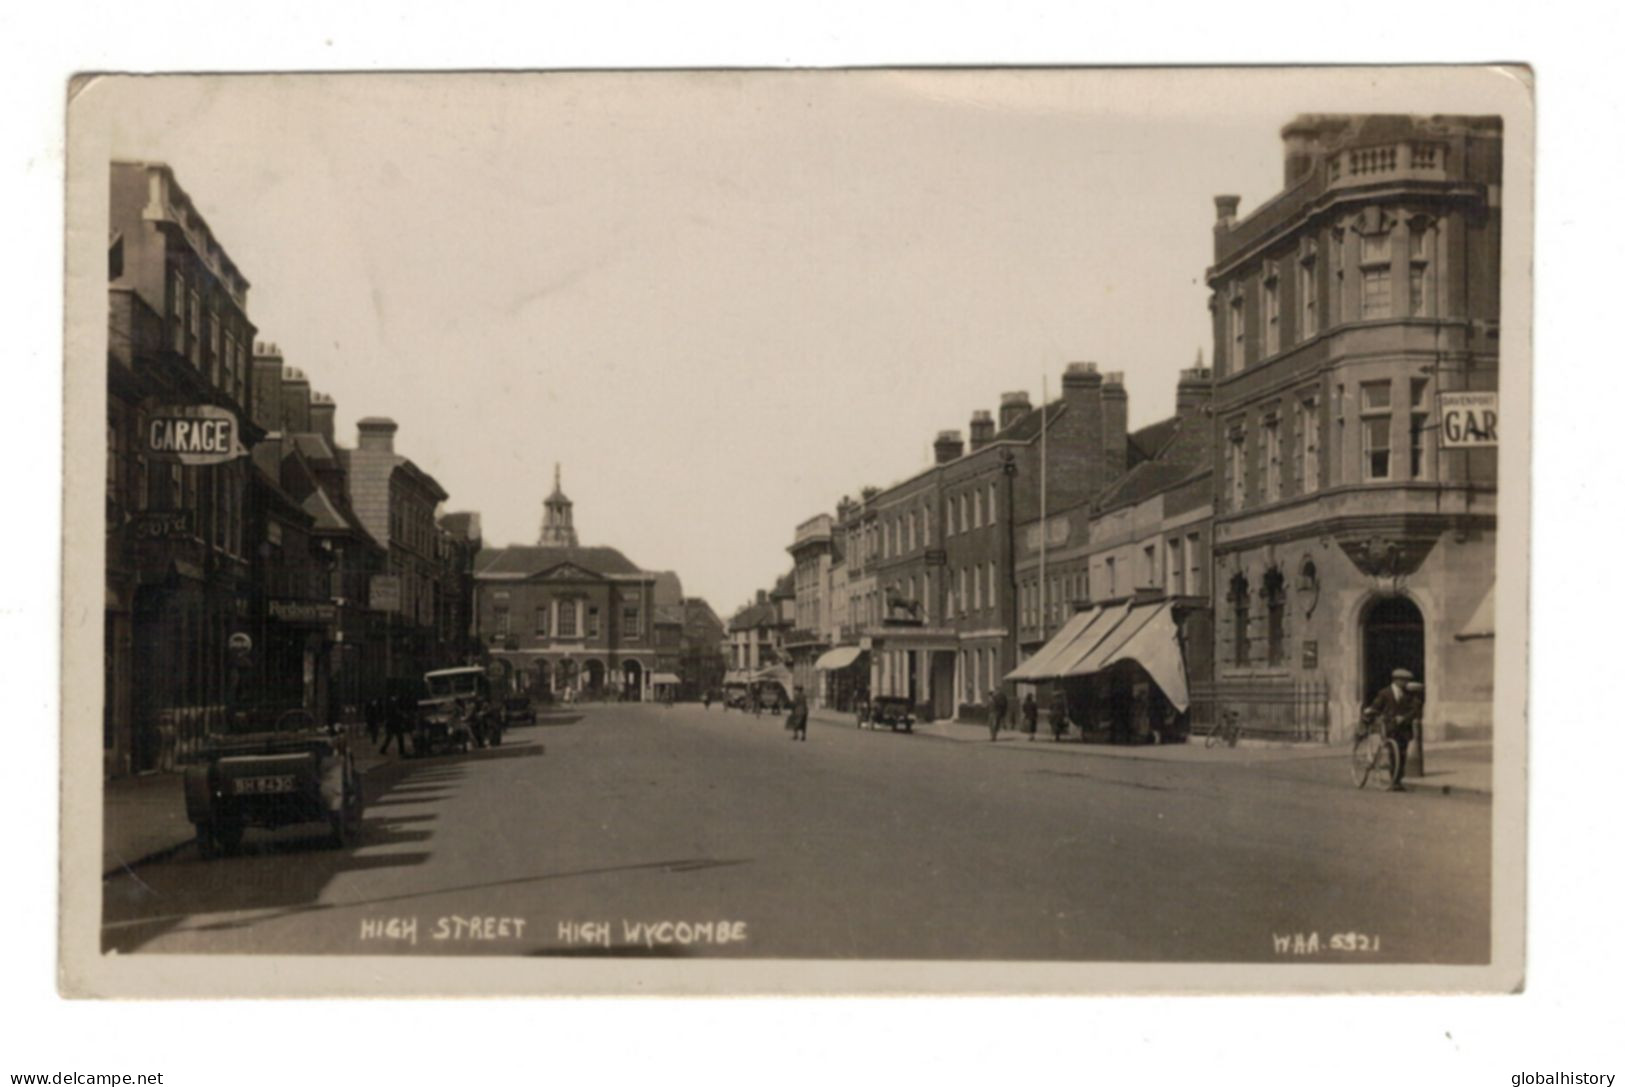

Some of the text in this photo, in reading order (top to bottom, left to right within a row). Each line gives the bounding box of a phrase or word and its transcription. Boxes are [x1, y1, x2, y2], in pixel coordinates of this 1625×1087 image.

[150, 419, 229, 452] GARAGE
[1445, 410, 1498, 442] GAR
[360, 916, 527, 945] HIGH STREET
[558, 920, 748, 949] HIGH WYCOMBE
